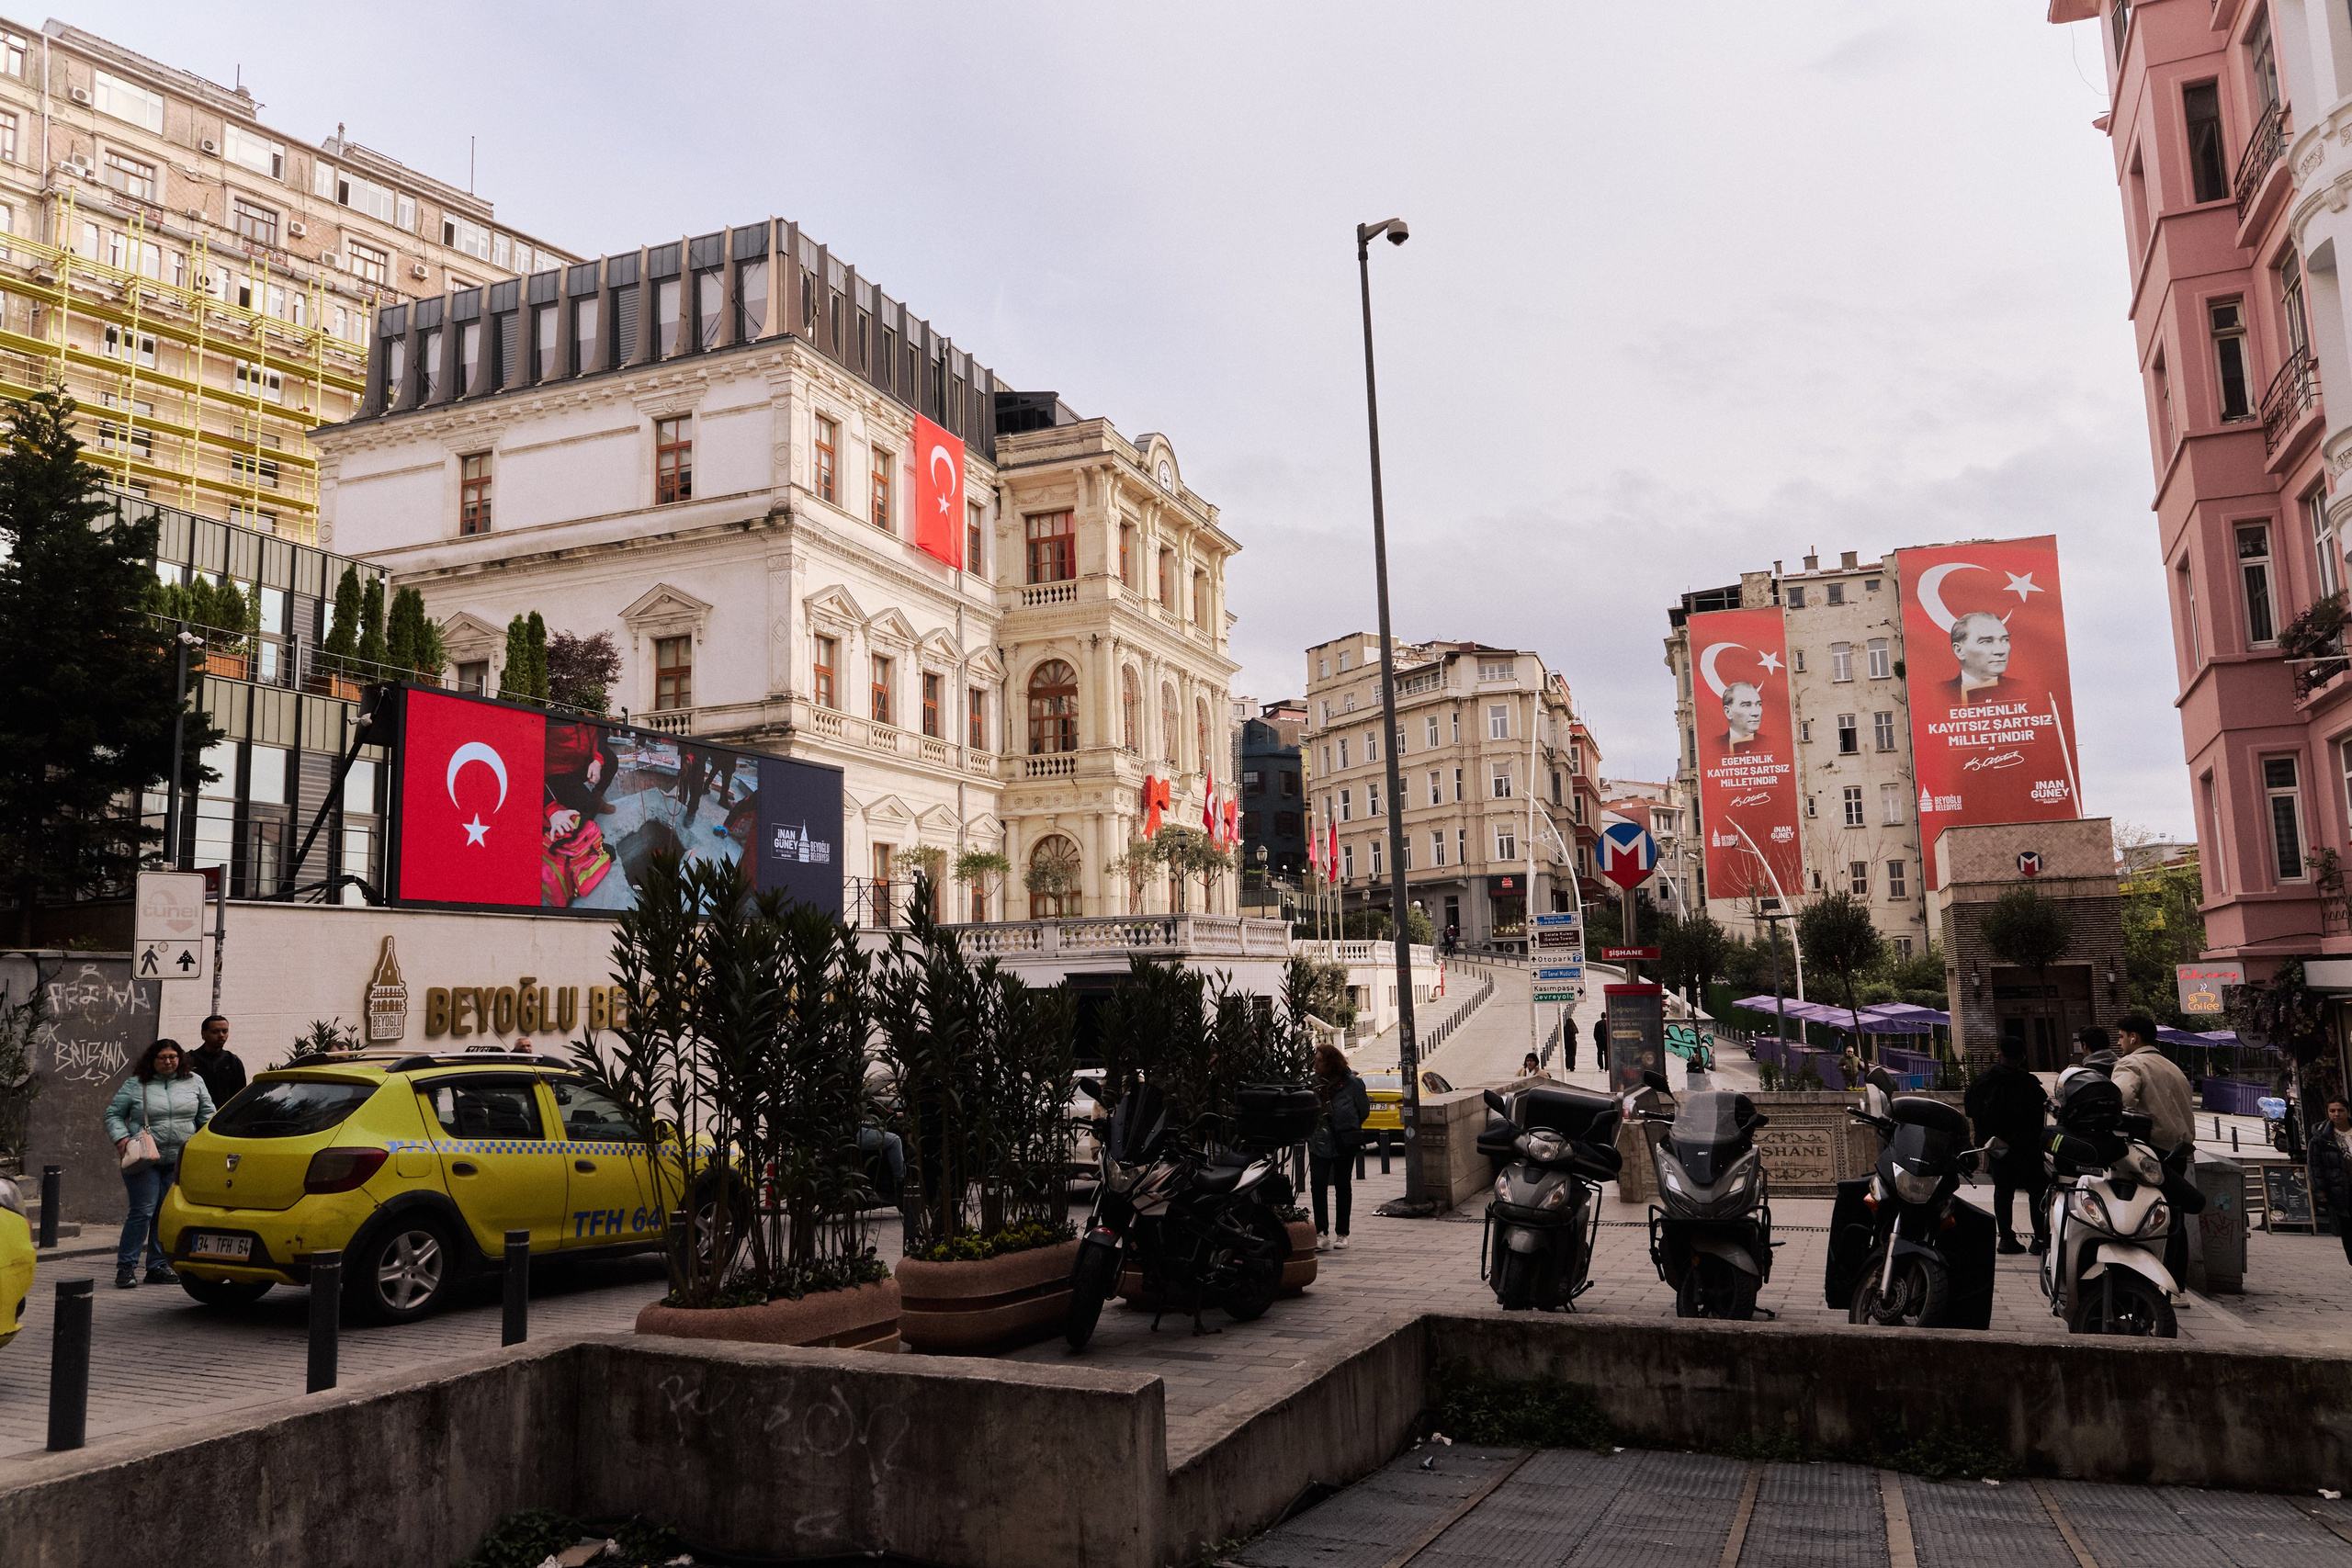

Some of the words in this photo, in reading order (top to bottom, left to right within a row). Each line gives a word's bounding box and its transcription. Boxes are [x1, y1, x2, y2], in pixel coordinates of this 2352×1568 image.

[1950, 703, 2028, 719] EGEMENLİK
[1928, 719, 1991, 734] KAYITSIZ
[1993, 714, 2053, 731] ŞARTSIZ
[1949, 729, 2035, 747] MİLLETİNDİR
[1722, 754, 1774, 766] EGEMENLİK
[1707, 766, 1749, 778] KAYITSIZ
[1750, 764, 1790, 776] ŞARTSIZ
[1721, 775, 1778, 788] MİLLETİNDİR
[2035, 780, 2064, 790] İNAN
[2030, 788, 2070, 799] GÜNEY
[1934, 795, 1962, 805] BEYOĞLU
[1935, 802, 1962, 812] BELEDİYESİ
[777, 829, 796, 840] İNAN
[1770, 831, 1794, 840] GÜNEY
[774, 838, 798, 851] GÜNEY
[1609, 949, 1644, 957] ŞİŞHANE
[1534, 993, 1575, 1001] Çevreyolu
[425, 977, 579, 1035] BEYOĞLU
[2188, 1002, 2220, 1011] Coffee
[373, 1012, 402, 1027] BEYOĞLU
[372, 1027, 401, 1037] BELEDİYESİ
[573, 1208, 625, 1238] TFH
[631, 1205, 662, 1233] 64
[198, 1236, 209, 1252] 34
[216, 1237, 233, 1254] TFH
[237, 1239, 249, 1255] 64
